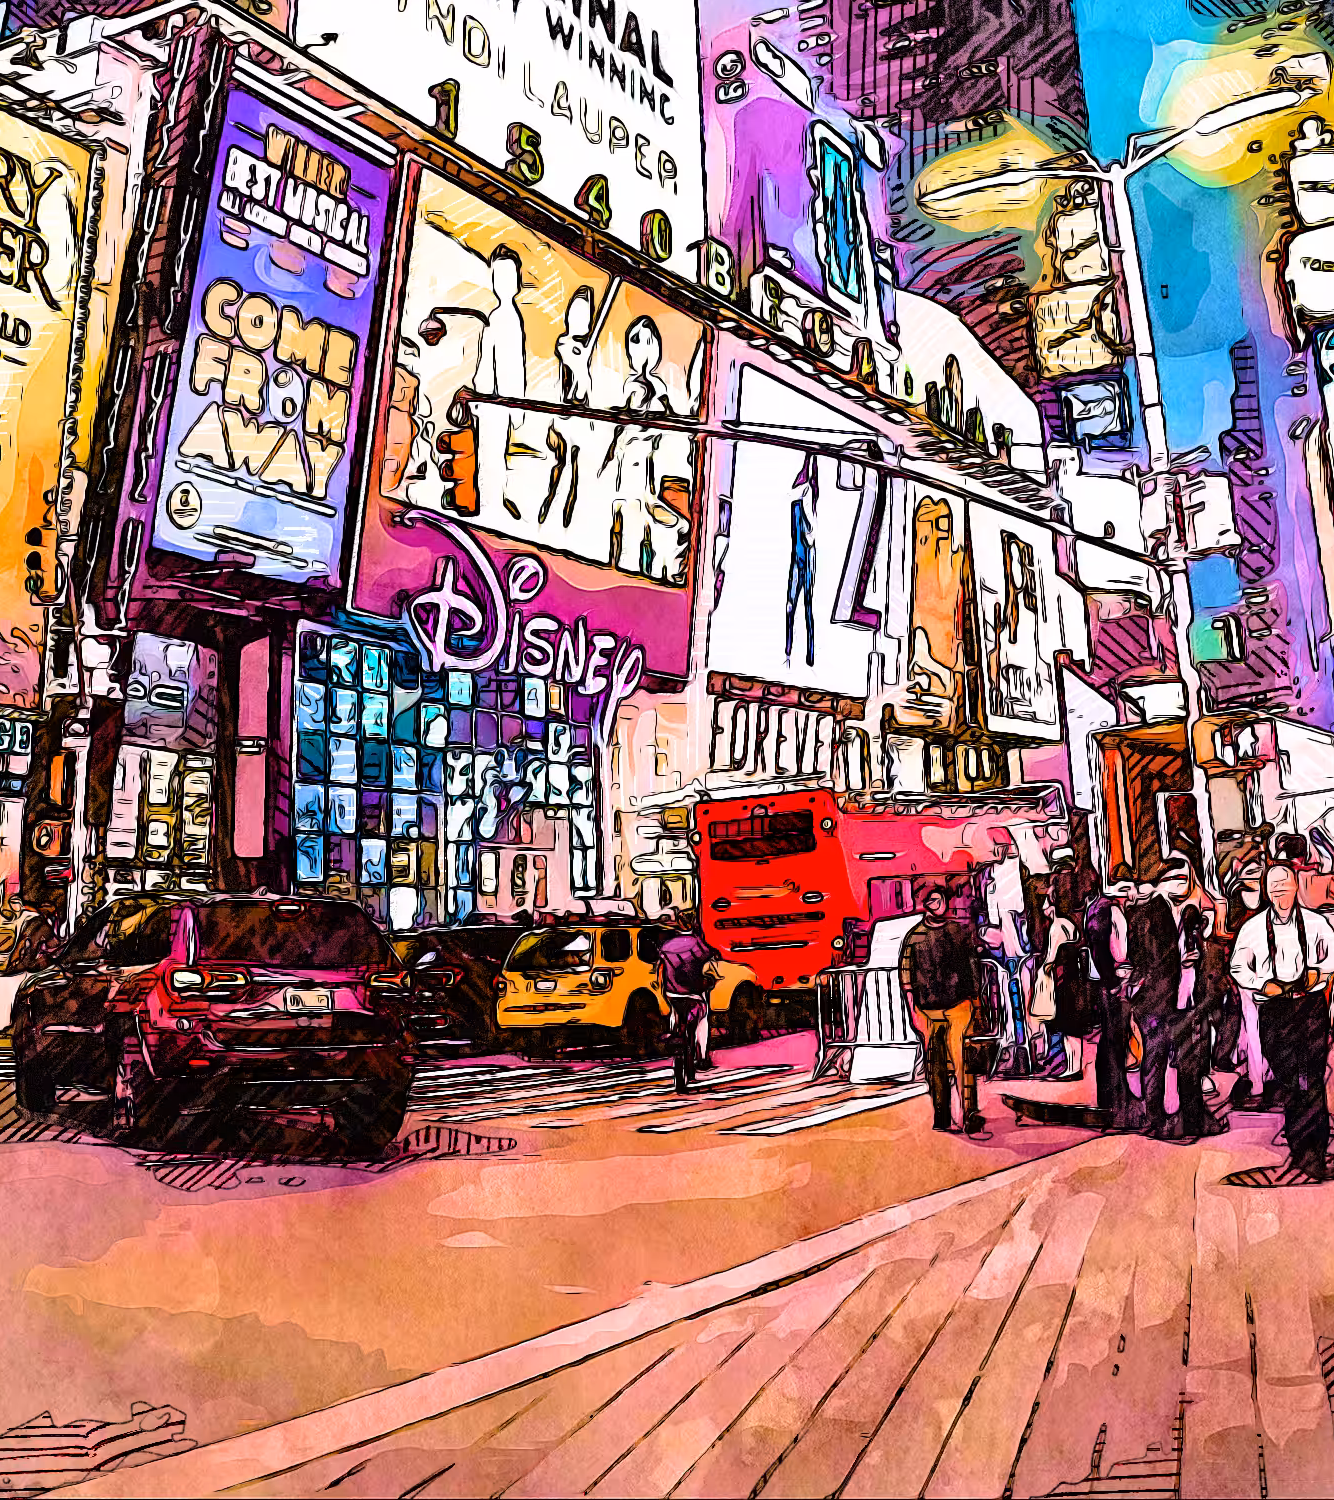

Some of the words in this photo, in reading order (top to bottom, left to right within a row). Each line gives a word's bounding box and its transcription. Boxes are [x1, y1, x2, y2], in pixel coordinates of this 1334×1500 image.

[545, 5, 675, 126] WINNING
[523, 60, 680, 197] LAUPER
[202, 276, 361, 387] COME
[189, 332, 353, 444] FROM
[177, 400, 348, 500] AWAY
